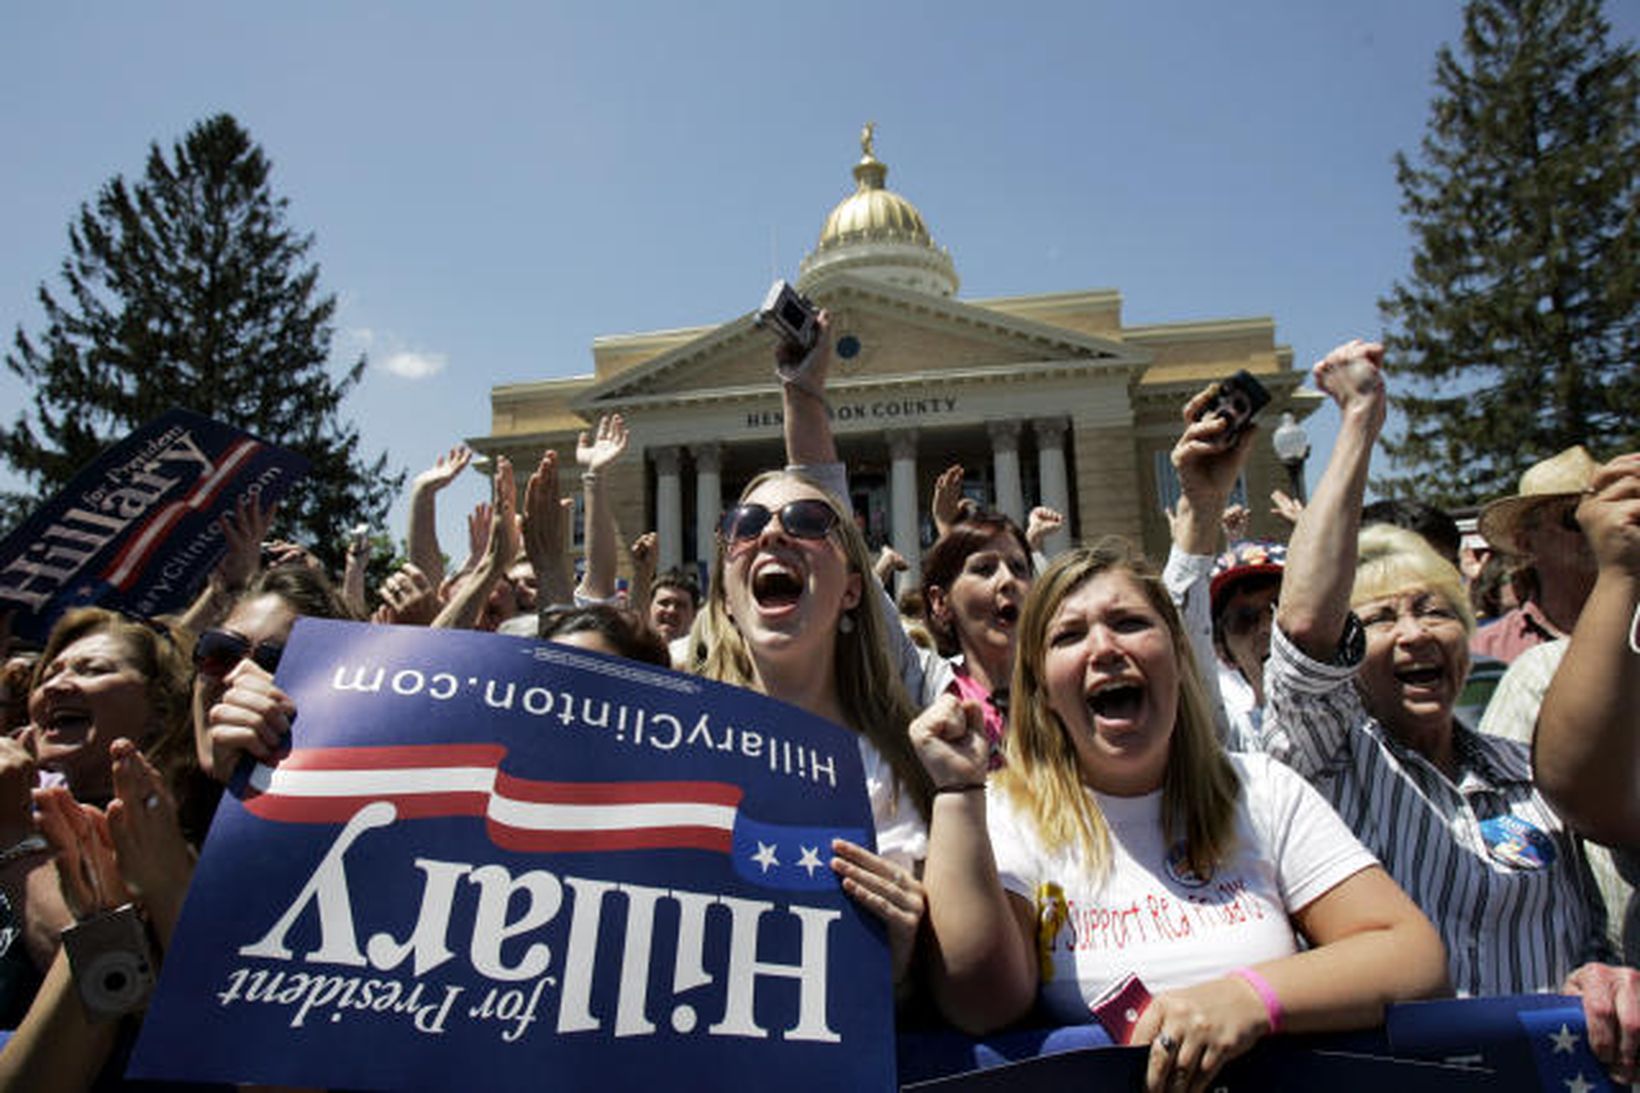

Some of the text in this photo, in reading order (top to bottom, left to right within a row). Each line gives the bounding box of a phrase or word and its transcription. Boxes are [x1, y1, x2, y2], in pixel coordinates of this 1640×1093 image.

[746, 397, 957, 427] HENON COUNTY
[0, 429, 216, 614] Hillary
[331, 664, 838, 788] HillaryClinton.com
[239, 800, 842, 1044] Hillary
[219, 966, 556, 1043] for President
